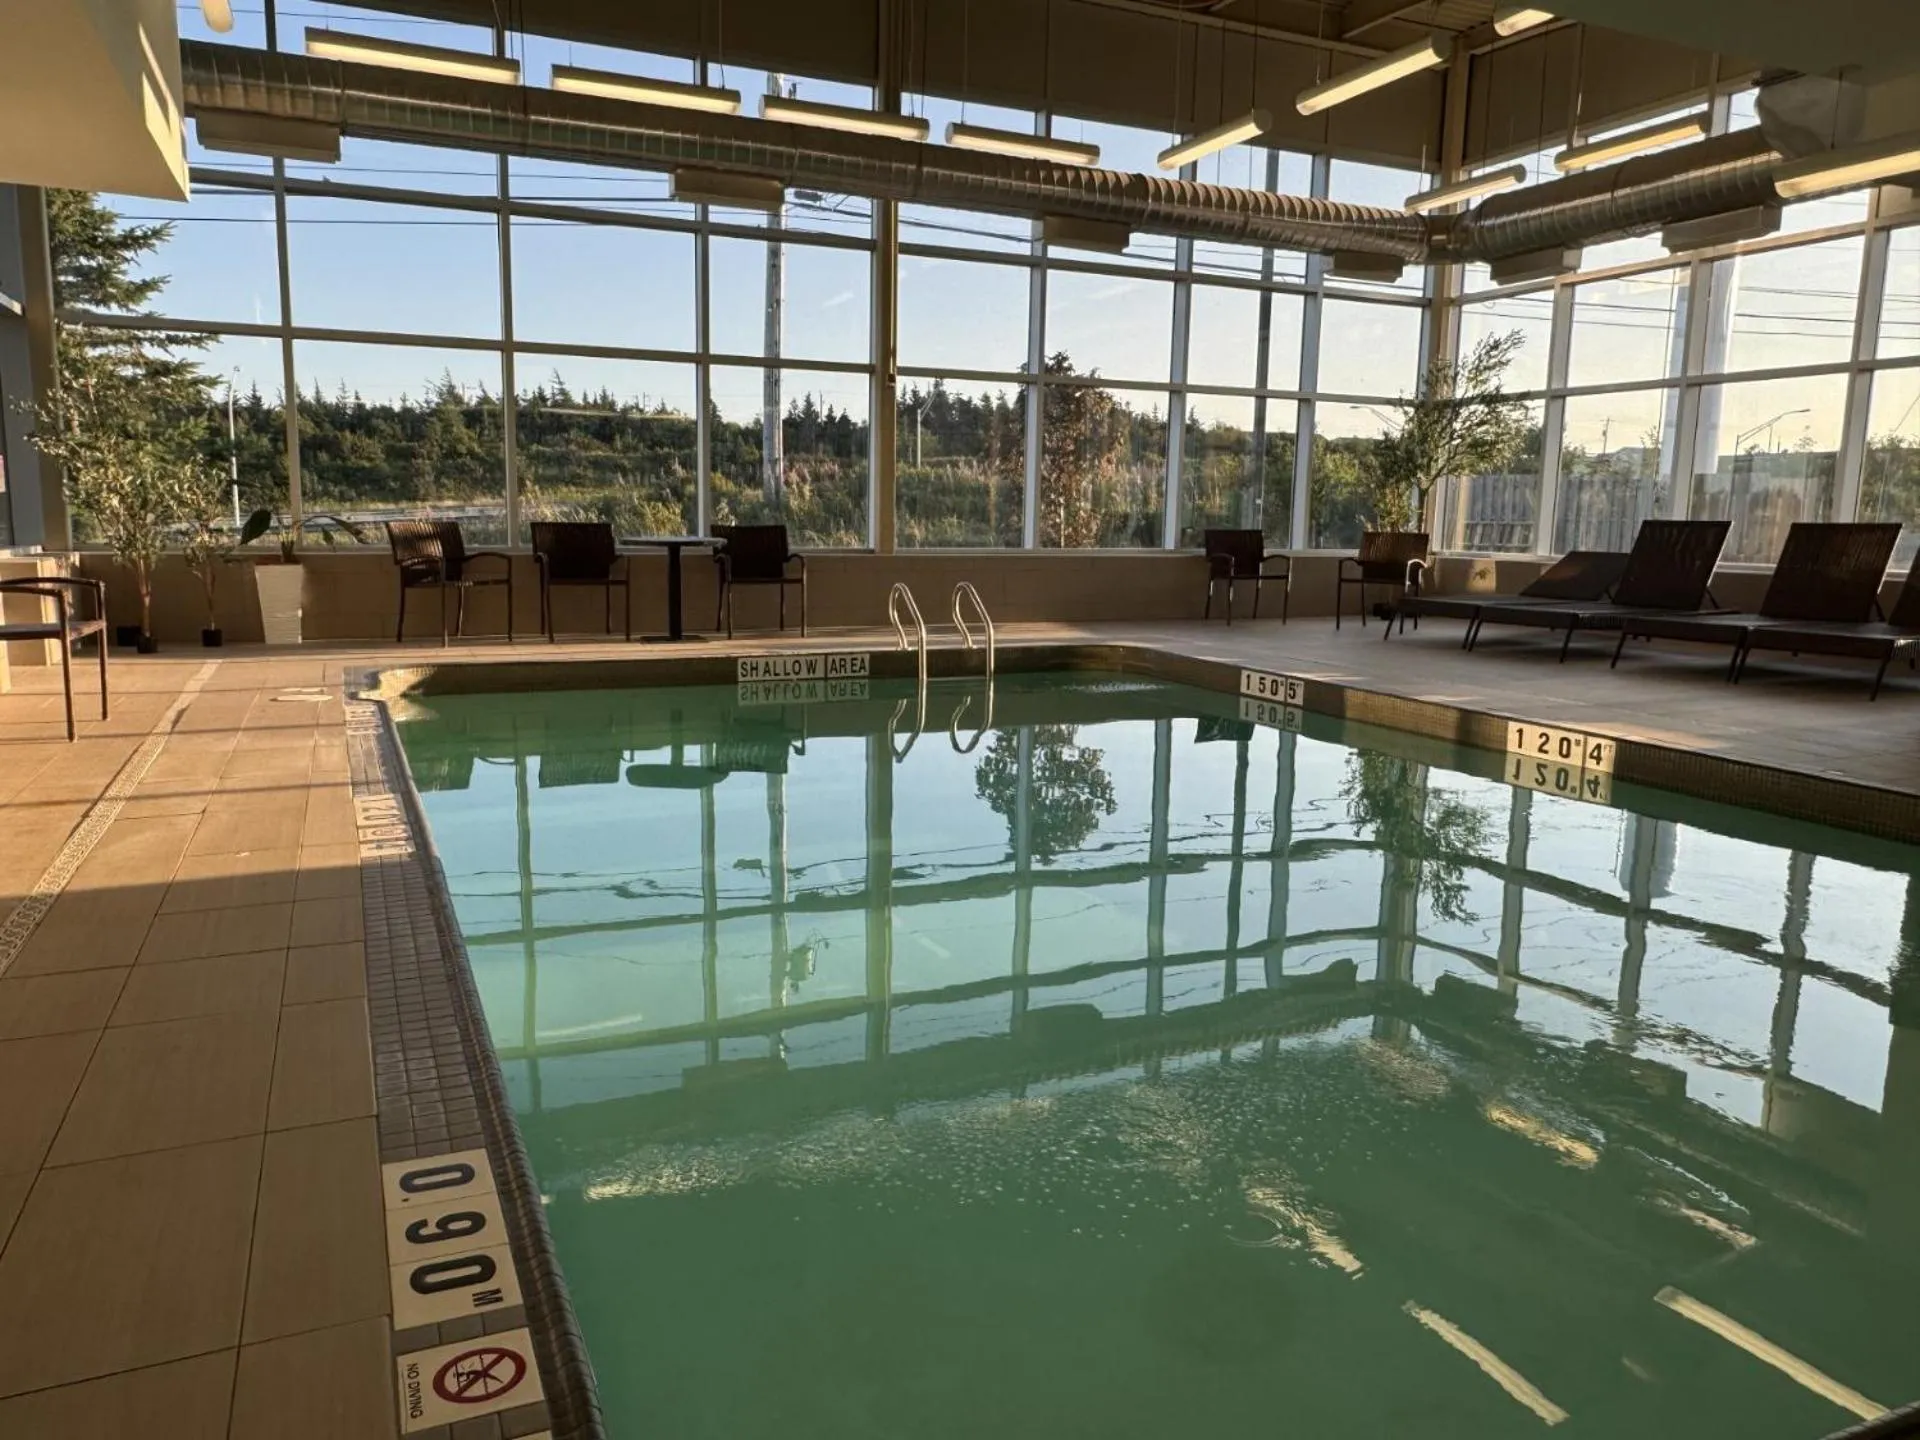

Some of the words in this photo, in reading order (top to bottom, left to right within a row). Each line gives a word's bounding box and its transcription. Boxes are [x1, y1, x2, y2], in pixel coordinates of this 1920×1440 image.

[740, 658, 818, 677] SHALLOW
[829, 657, 867, 674] AREA
[407, 1362, 420, 1379] NO
[408, 1381, 424, 1419] DIVING
